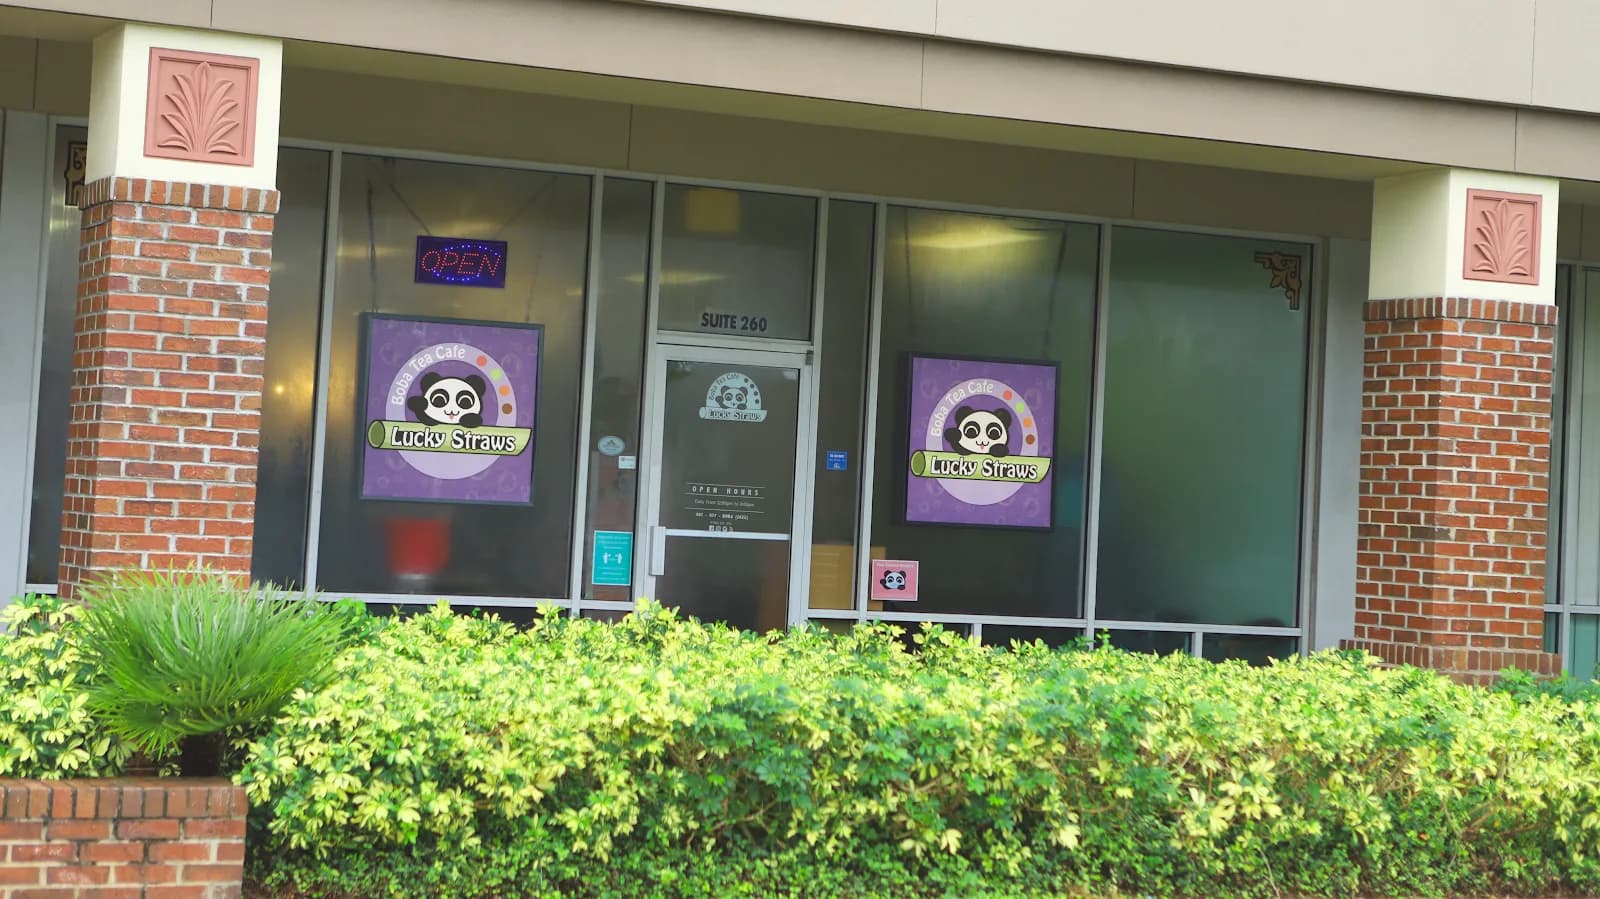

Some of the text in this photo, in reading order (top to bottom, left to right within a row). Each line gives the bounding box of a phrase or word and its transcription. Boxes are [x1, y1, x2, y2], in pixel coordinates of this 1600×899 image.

[421, 250, 501, 276] OPEN
[701, 312, 767, 332] SUITE 260
[391, 345, 466, 405] Boba Tea Cafe
[930, 380, 993, 437] Boba Tea Cafe
[391, 426, 516, 452] Lucky Straws
[931, 456, 1038, 479] Lucky Straws
[692, 485, 759, 496] OPEN HOURS
